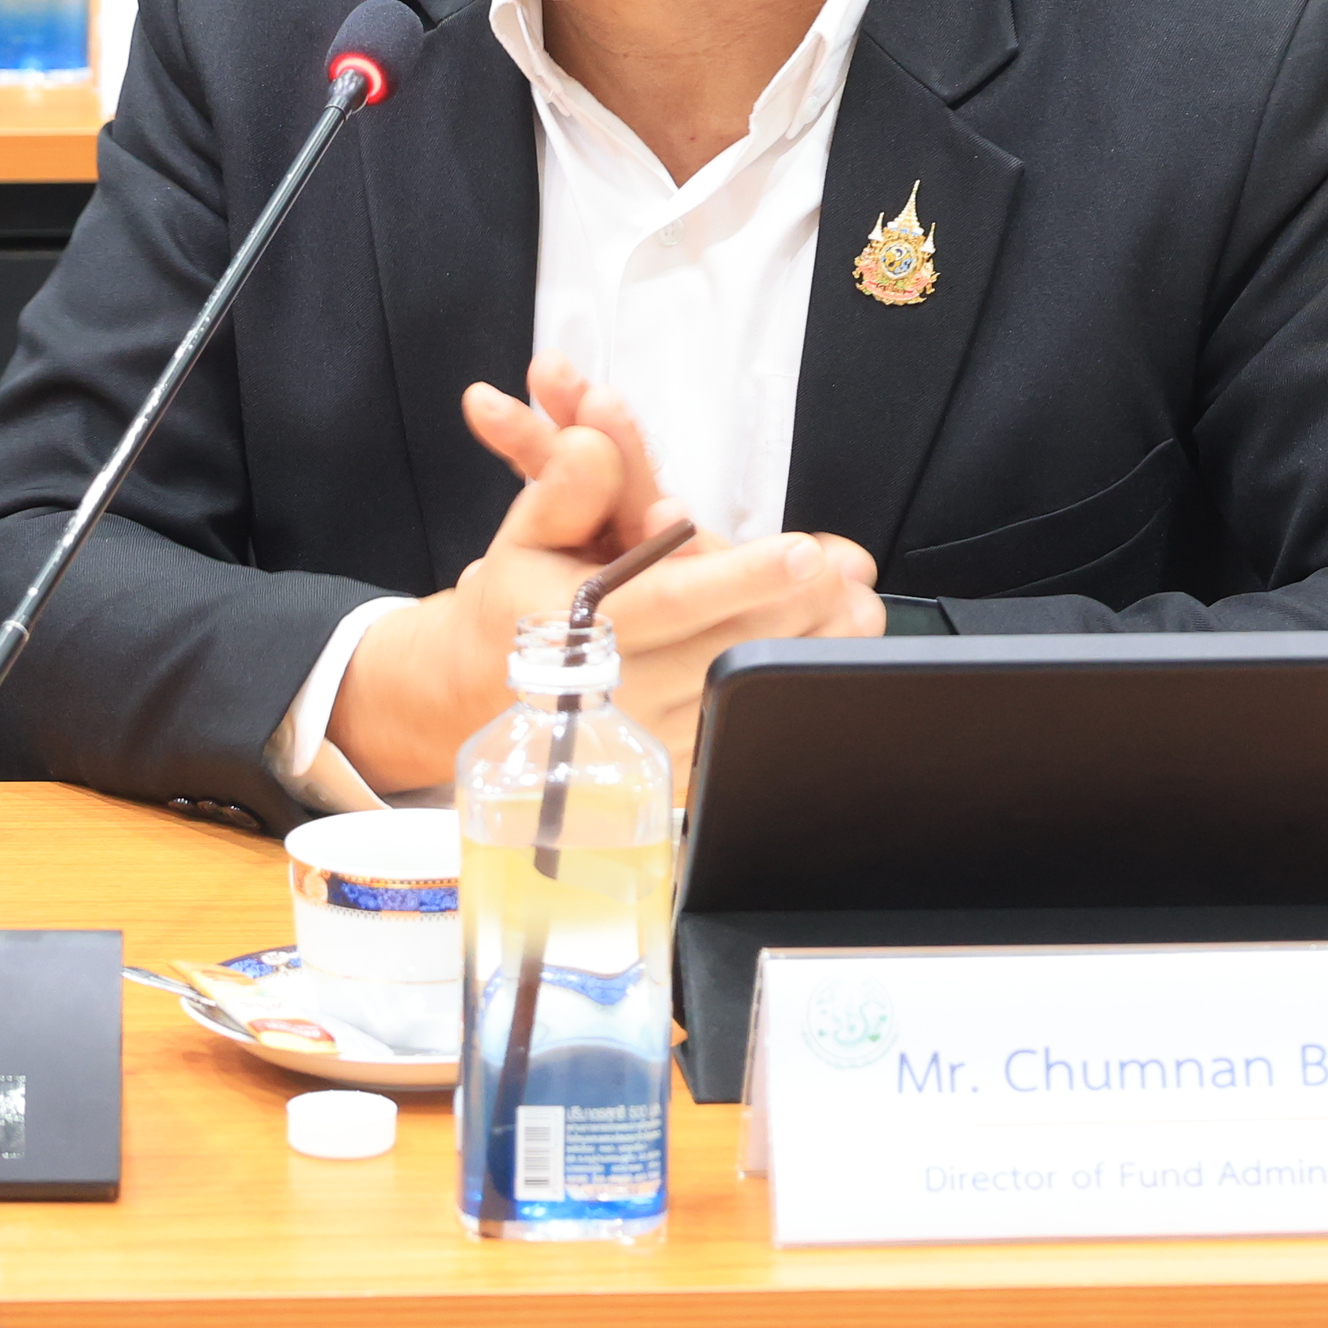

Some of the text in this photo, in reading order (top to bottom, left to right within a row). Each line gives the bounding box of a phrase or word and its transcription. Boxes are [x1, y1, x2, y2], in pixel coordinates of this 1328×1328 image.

[896, 1049, 980, 1095] Mr.
[1003, 1044, 1275, 1094] Chumnan
[924, 1164, 1055, 1194] Director
[1071, 1162, 1105, 1191] of
[1119, 1161, 1204, 1190] Fund
